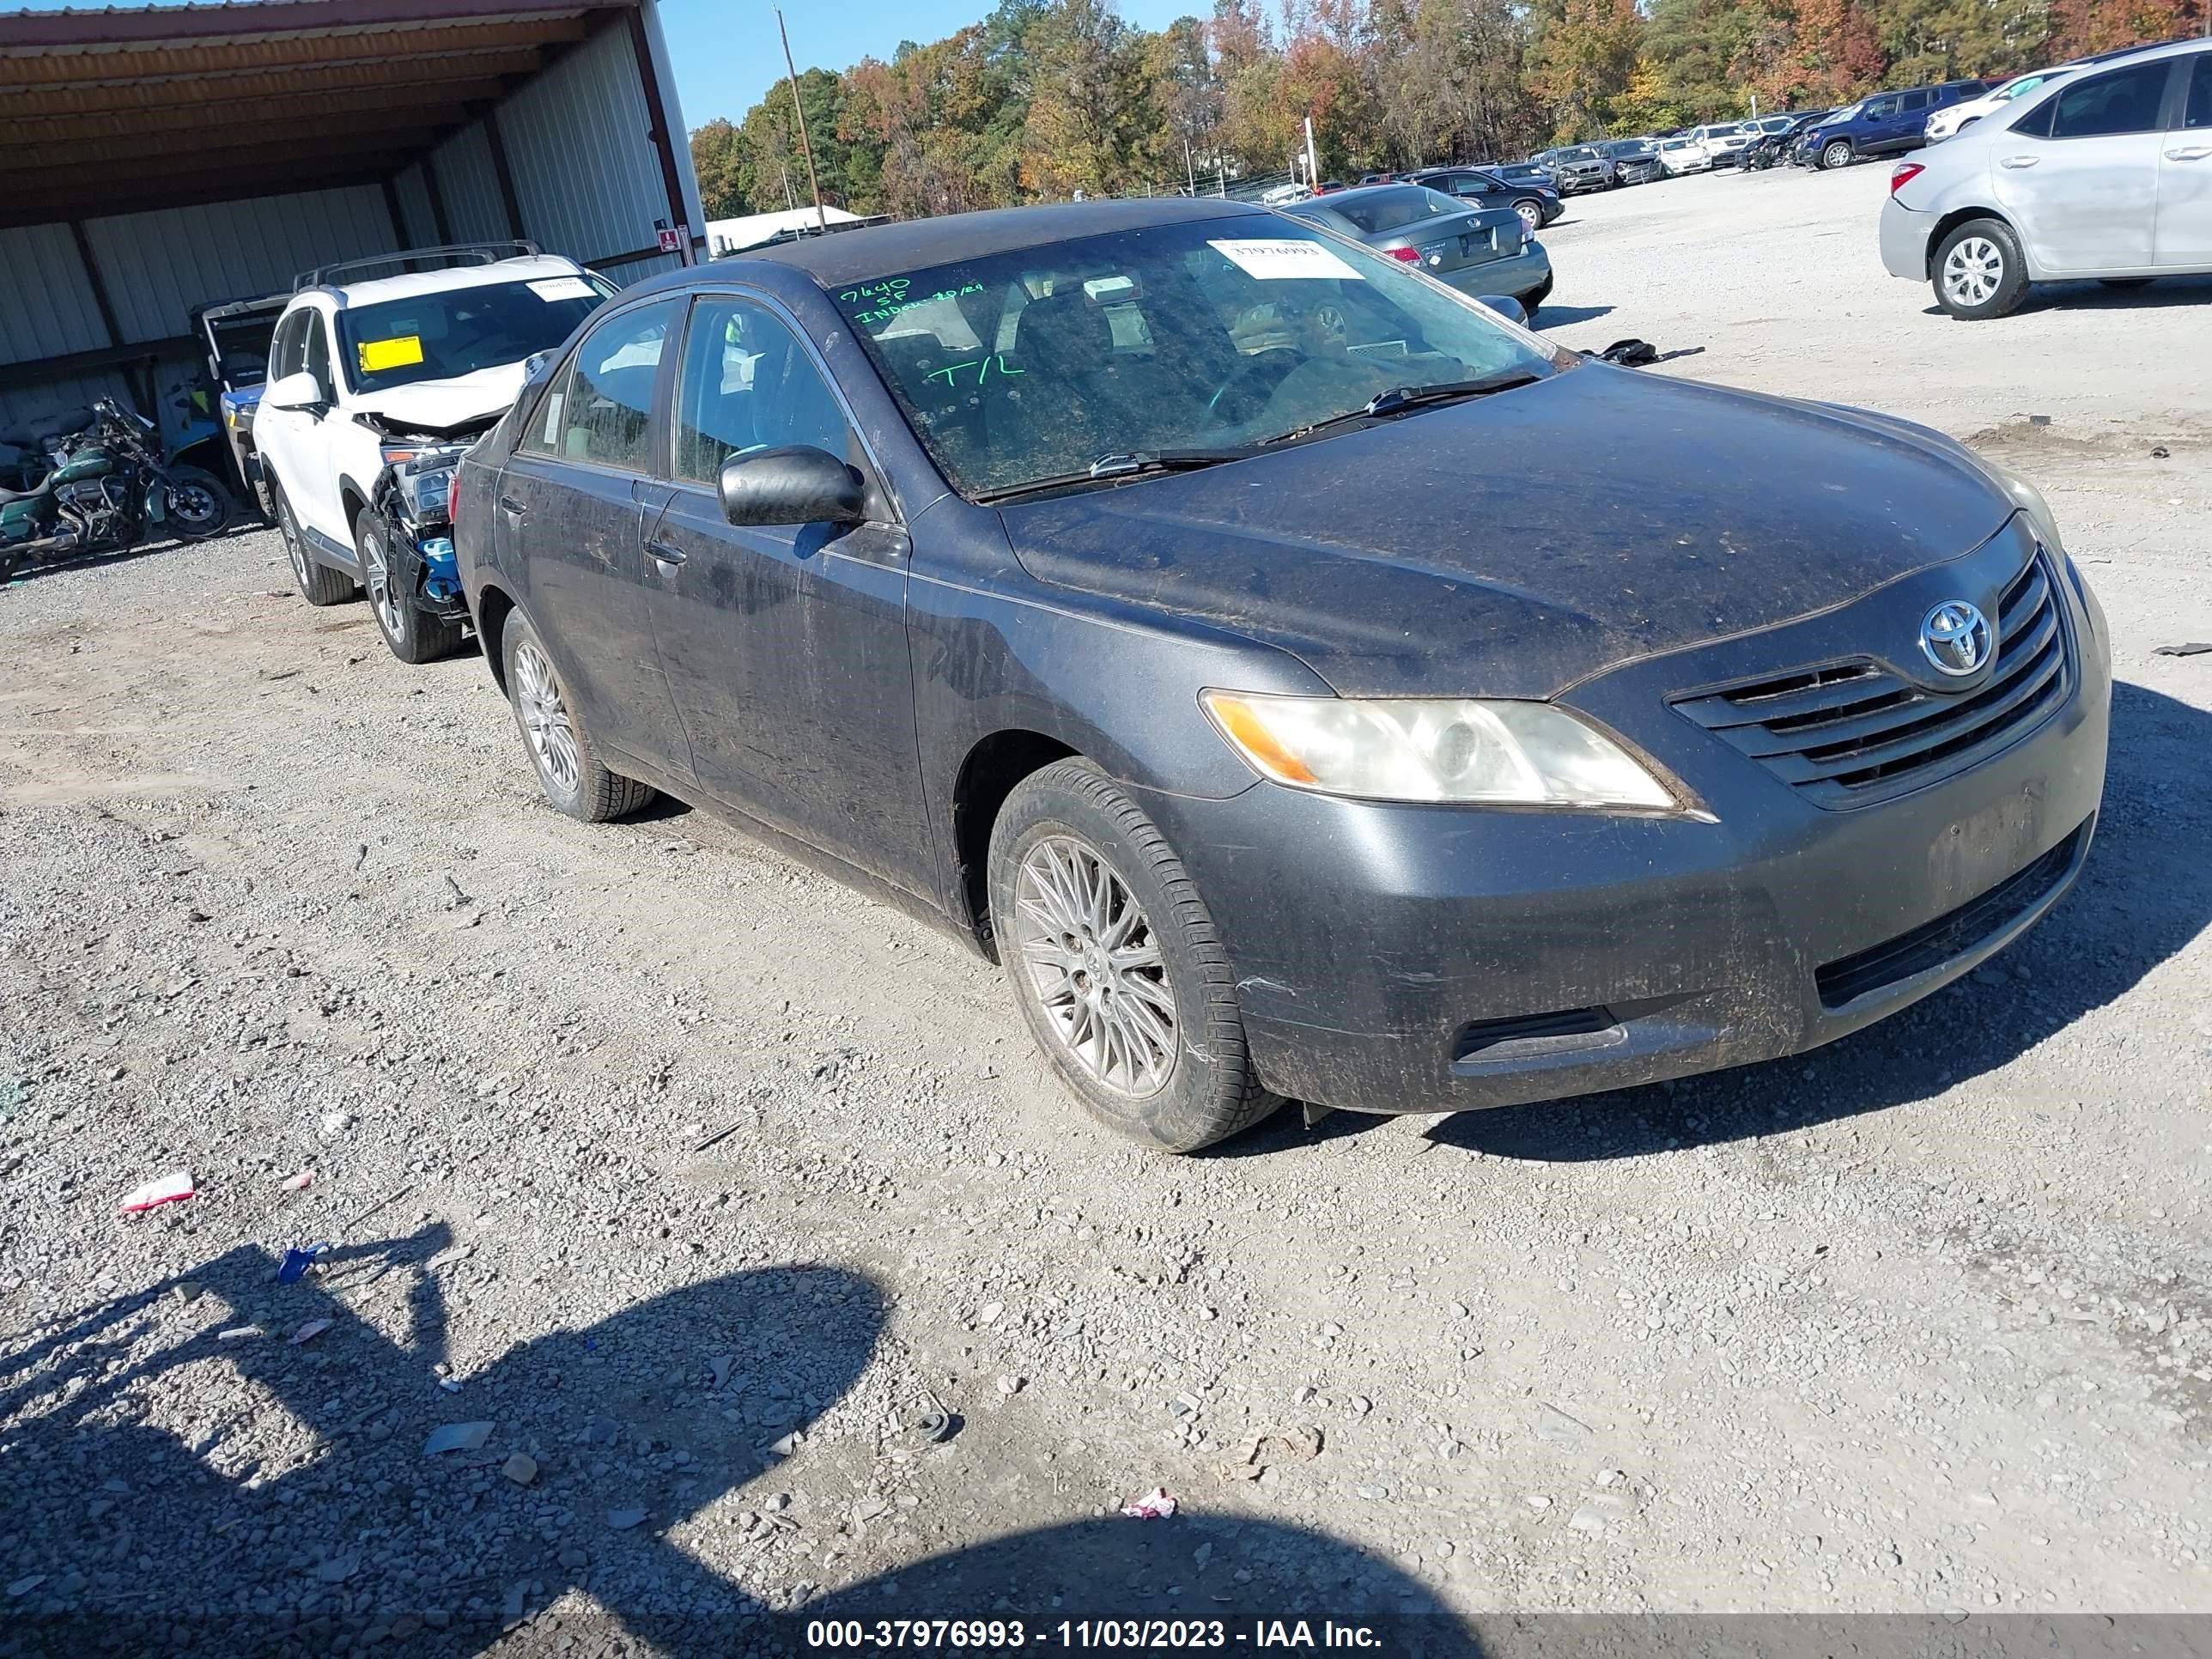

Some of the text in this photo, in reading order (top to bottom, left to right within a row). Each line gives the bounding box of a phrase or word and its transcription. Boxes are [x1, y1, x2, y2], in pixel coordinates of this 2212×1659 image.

[1230, 246, 1321, 257] 37976993
[840, 278, 911, 303] 7640
[876, 290, 908, 307] SF
